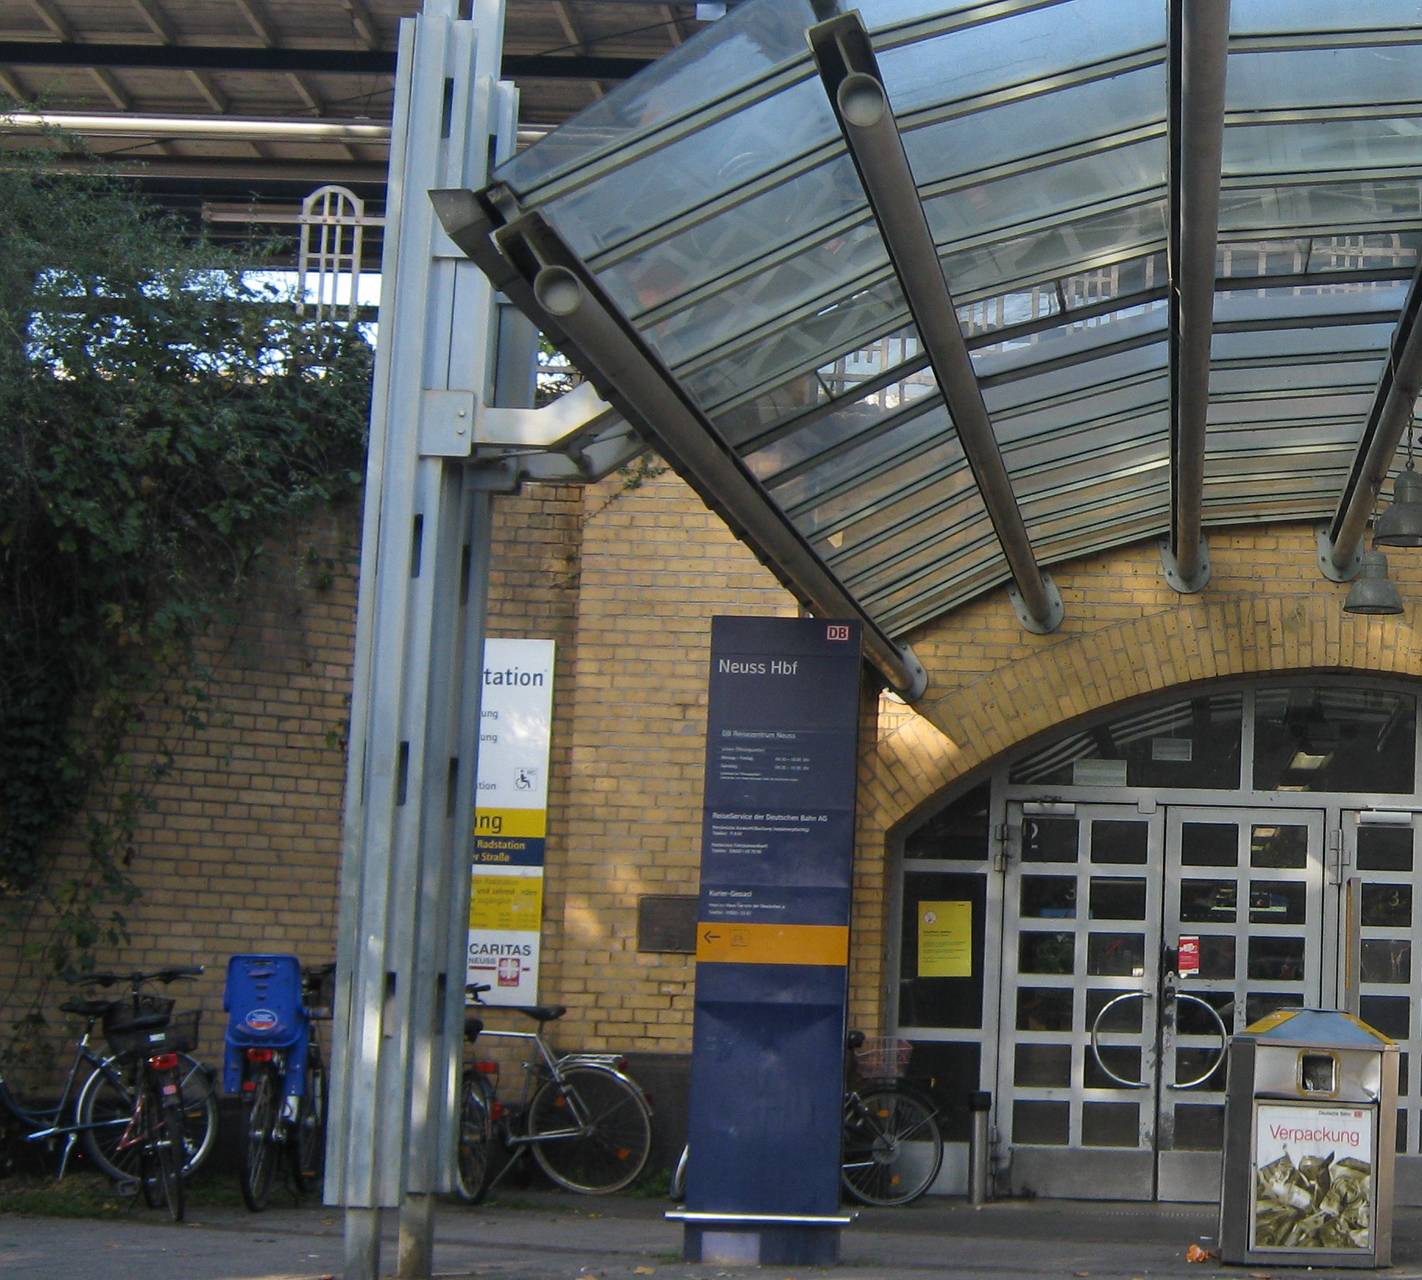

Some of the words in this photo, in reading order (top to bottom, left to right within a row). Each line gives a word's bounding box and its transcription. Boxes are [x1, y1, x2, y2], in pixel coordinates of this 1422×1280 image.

[828, 627, 848, 640] DB
[719, 659, 766, 674] Neuss
[771, 661, 798, 675] Hbf
[477, 839, 527, 850] Radstation
[480, 852, 510, 862] Straße
[469, 943, 532, 956] CARITAS
[1270, 1124, 1360, 1147] Verpackung
